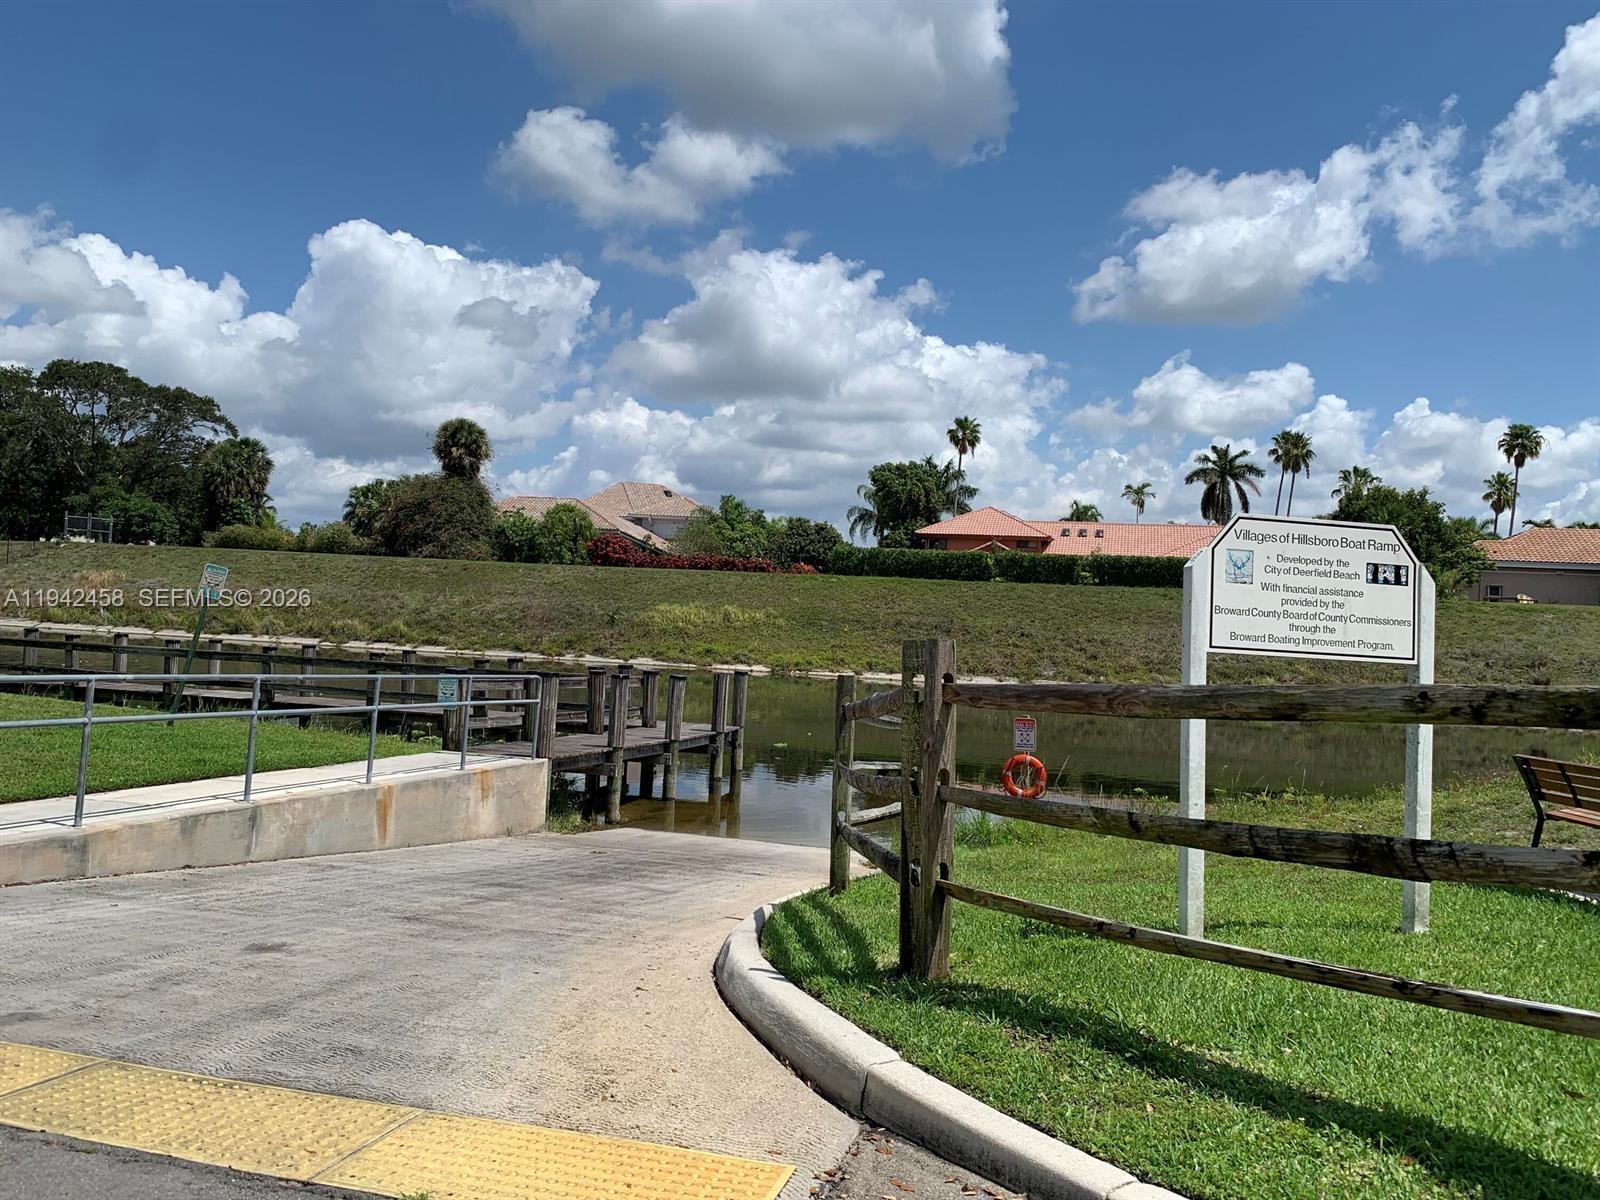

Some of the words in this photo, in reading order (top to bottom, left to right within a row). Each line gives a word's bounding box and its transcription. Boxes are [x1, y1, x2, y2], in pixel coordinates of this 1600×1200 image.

[1234, 528, 1278, 546] Villages
[1279, 532, 1291, 544] of
[1291, 533, 1339, 548] Hillsboro
[1340, 537, 1367, 550] Boat
[1367, 539, 1401, 554] Ramp
[1276, 554, 1323, 567] Developed
[1324, 557, 1334, 568] by
[1336, 558, 1350, 568] the
[1264, 565, 1283, 576] City
[1283, 567, 1292, 576] of
[1293, 567, 1332, 579] Deerfield
[1333, 570, 1361, 580] Beach
[1260, 582, 1281, 592] With
[1282, 583, 1317, 595] financial
[1318, 588, 1364, 598] assistance
[1281, 598, 1318, 608] provided
[1319, 599, 1330, 610] by
[1331, 600, 1345, 609] the
[1214, 605, 1250, 617] Broward
[1251, 608, 1281, 620] County
[1282, 610, 1309, 621] Board
[1309, 611, 1318, 621] of
[1318, 612, 1348, 624] County
[1348, 614, 1412, 627] Commissioners
[1288, 623, 1321, 634] through
[1322, 625, 1336, 634] the
[1229, 632, 1266, 643] Broward
[1268, 634, 1300, 647] Boating
[1301, 636, 1356, 648] Improvement
[1357, 640, 1395, 651] Program.
